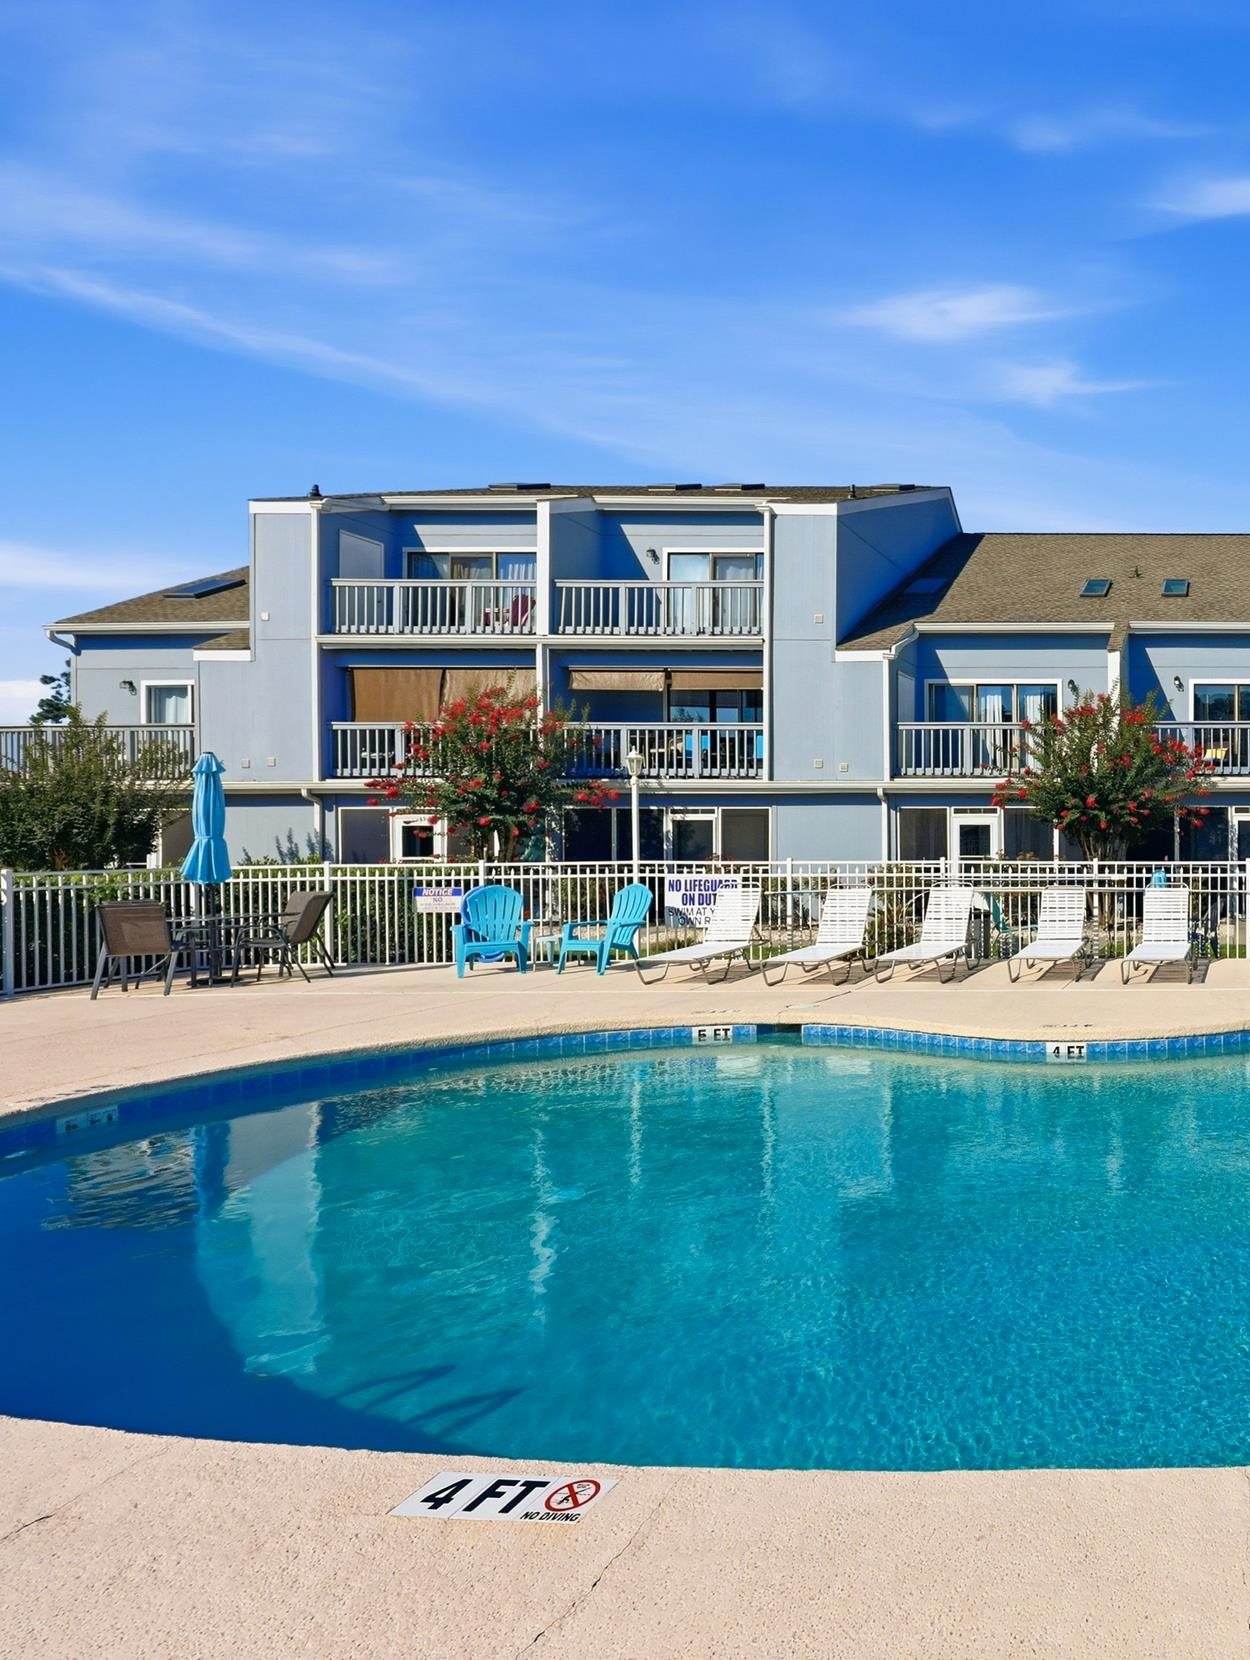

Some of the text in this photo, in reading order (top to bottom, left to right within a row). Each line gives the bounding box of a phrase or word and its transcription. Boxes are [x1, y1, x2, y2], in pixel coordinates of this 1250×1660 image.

[668, 879, 682, 892] NO
[422, 888, 453, 896] NOTICE
[681, 893, 718, 906] ON DUT
[668, 906, 694, 917] SWIM
[696, 907, 708, 916] AT
[678, 916, 702, 926] OWN
[420, 1478, 551, 1514] 4 FT
[520, 1511, 581, 1521] NO DIVING
